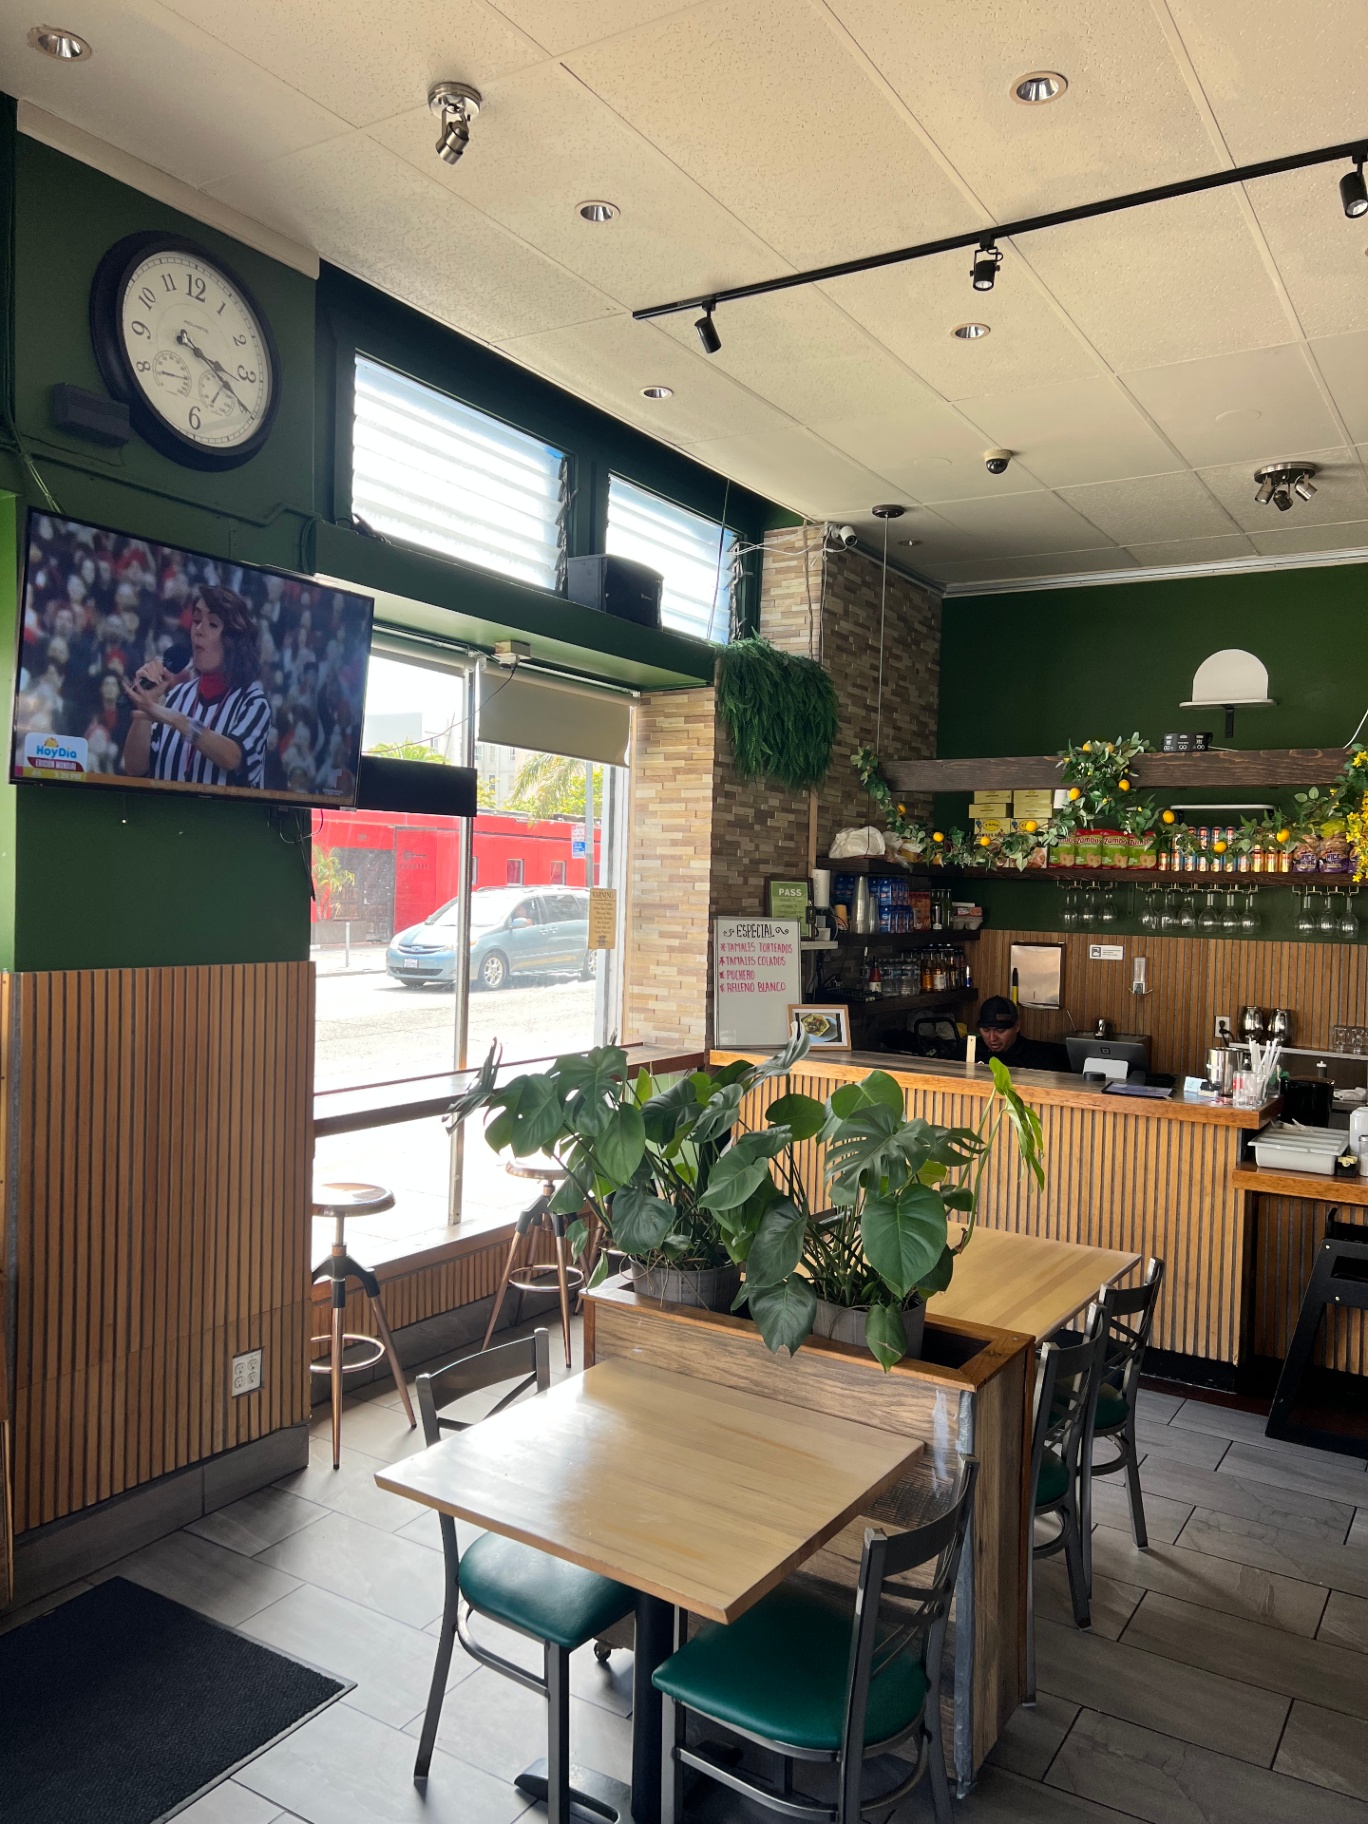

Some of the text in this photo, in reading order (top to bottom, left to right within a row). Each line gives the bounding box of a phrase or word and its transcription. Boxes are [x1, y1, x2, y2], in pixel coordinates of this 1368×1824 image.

[161, 272, 178, 293] 11
[185, 273, 207, 303] 12
[138, 286, 157, 312] 10
[216, 301, 226, 316] 1
[131, 319, 152, 340] 9
[232, 333, 248, 348] 2
[136, 360, 152, 374] 8
[236, 363, 258, 385] 3
[188, 405, 203, 431] 6
[778, 888, 802, 897] PASS
[736, 923, 775, 938] ESPECIAL
[726, 942, 793, 954] TAMALES TORTEADOS
[726, 956, 786, 966] TAMALES COLADOS
[726, 970, 755, 980] PUCHERO
[727, 981, 786, 993] RELLENO BLANCO
